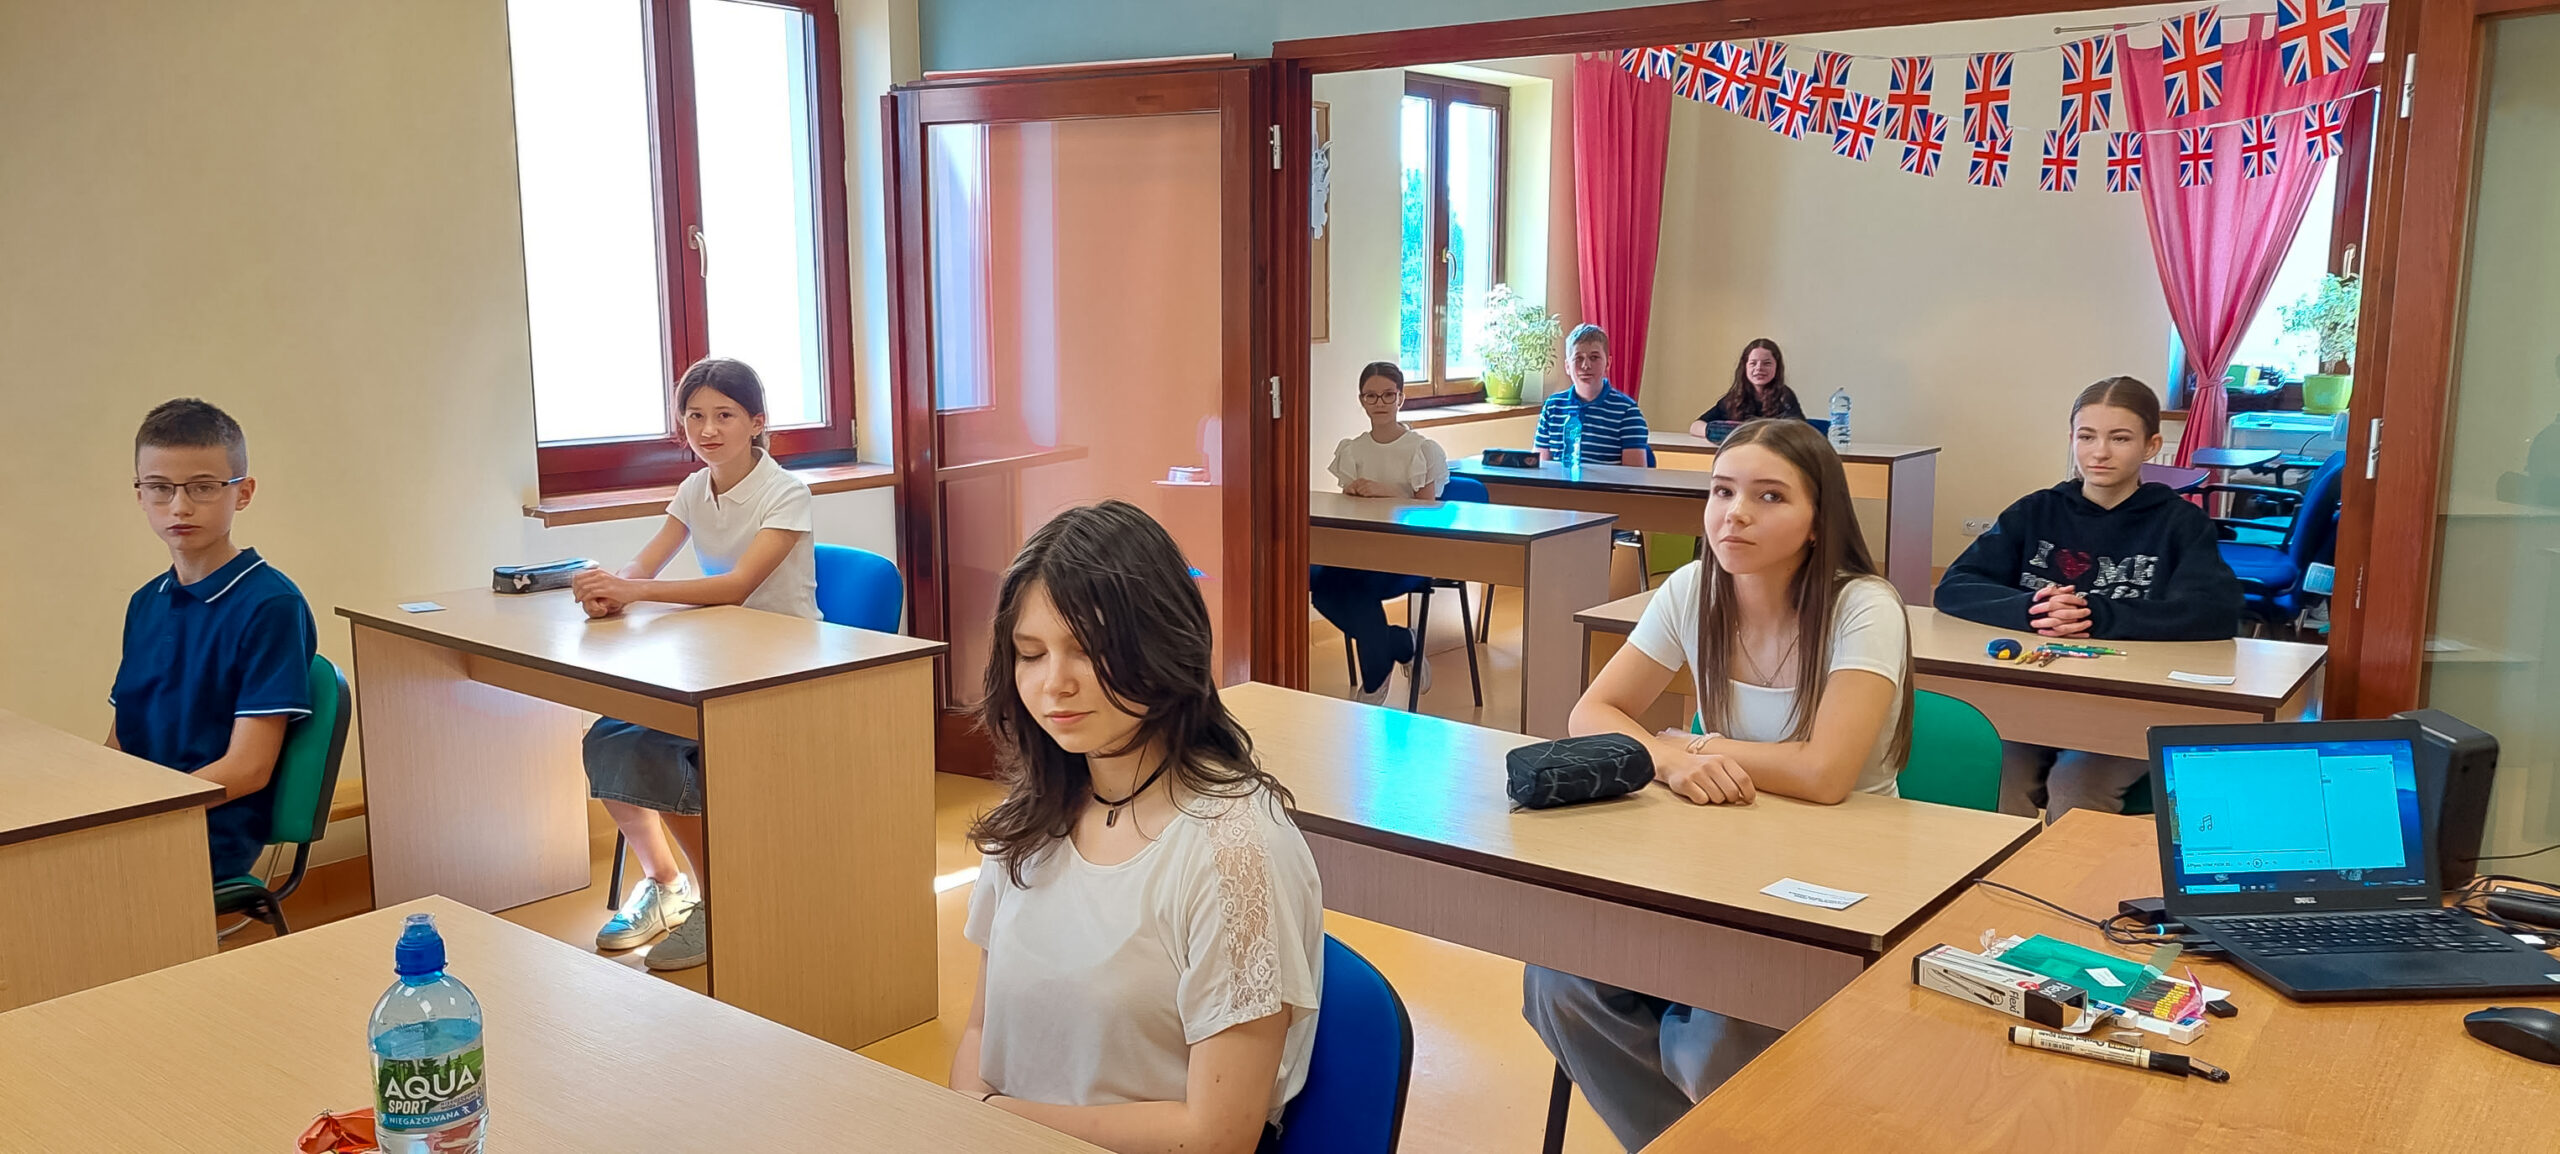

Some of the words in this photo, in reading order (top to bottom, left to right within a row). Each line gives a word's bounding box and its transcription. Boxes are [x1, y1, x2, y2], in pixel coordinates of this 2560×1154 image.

[2029, 540, 2055, 569] I
[2093, 554, 2159, 586] ME
[384, 1065, 475, 1101] AQUA
[388, 1099, 430, 1115] SPORT
[389, 1111, 460, 1125] NIEGAZOWANA
